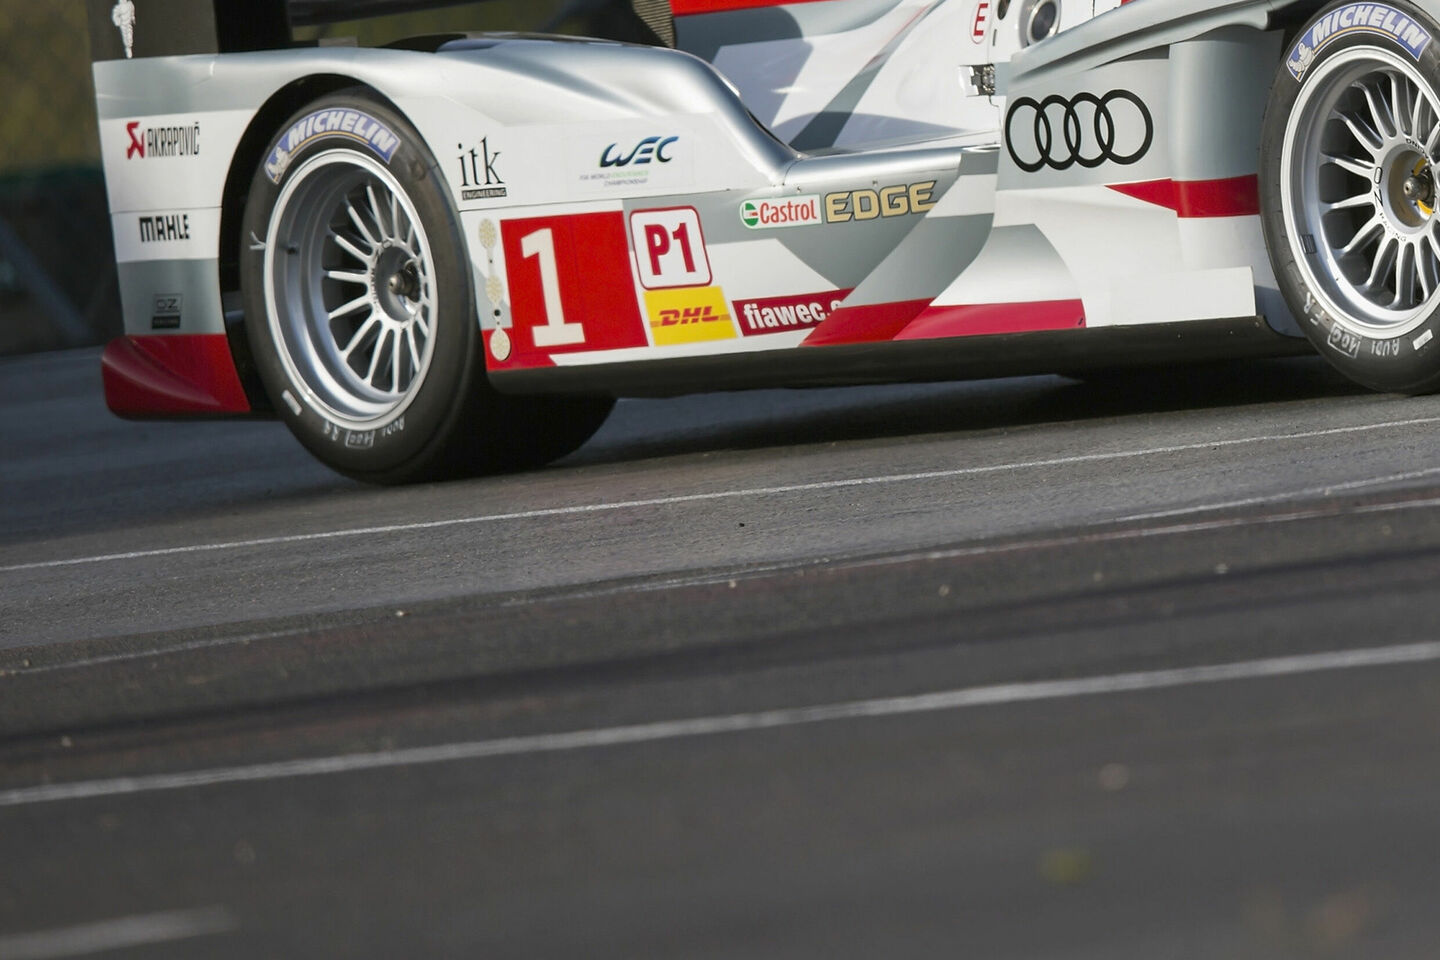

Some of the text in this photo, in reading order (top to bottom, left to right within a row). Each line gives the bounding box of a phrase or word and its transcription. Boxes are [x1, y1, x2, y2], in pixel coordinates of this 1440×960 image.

[973, 3, 989, 36] E
[1311, 5, 1427, 50] MICHELIN
[287, 110, 395, 153] MICHELIN
[599, 136, 680, 168] WEC
[457, 136, 505, 187] itk
[759, 179, 938, 224] Castrol EDGE
[139, 214, 190, 243] MAHLE
[644, 222, 696, 276] P1
[520, 227, 586, 347] 1
[658, 305, 720, 327] DHL
